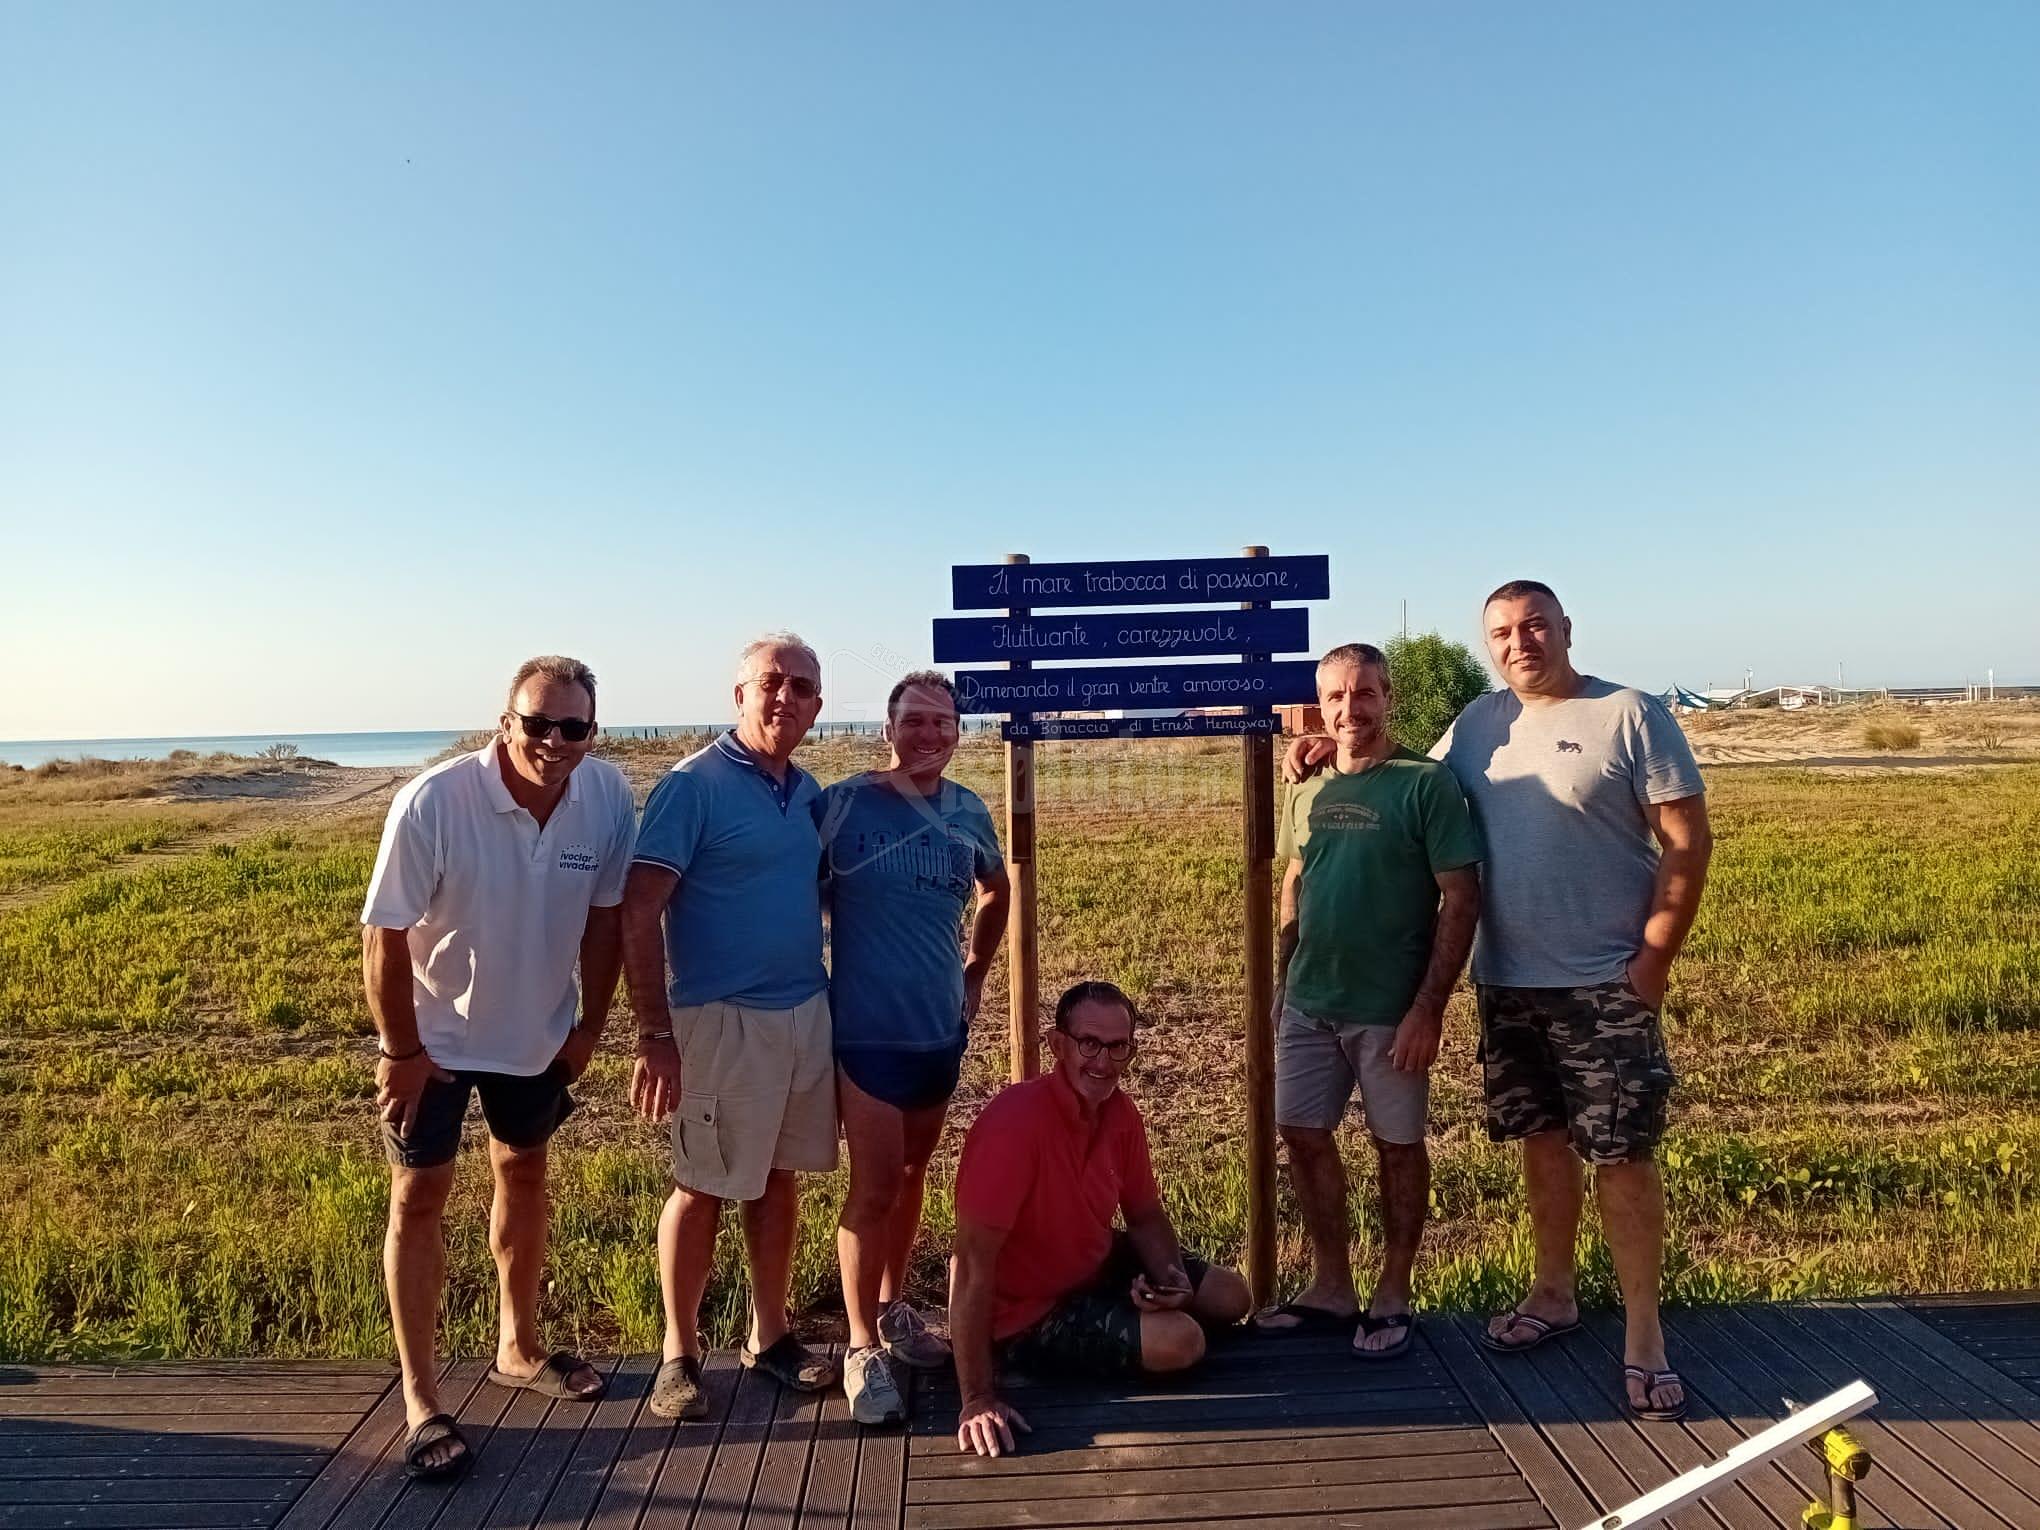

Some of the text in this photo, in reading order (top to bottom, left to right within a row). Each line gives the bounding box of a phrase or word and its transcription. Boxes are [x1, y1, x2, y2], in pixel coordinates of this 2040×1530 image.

[1023, 577, 1073, 594] mare
[1084, 570, 1167, 593] trabocca
[1179, 566, 1199, 590] di
[960, 676, 1059, 700] Dimenando
[1067, 677, 1076, 697] il
[1081, 682, 1119, 707] gran
[1129, 676, 1171, 695] ventre
[1009, 722, 1029, 735] da
[1128, 719, 1142, 732] di
[1152, 717, 1196, 732] Ernest
[1204, 716, 1276, 736] Hemigway
[559, 861, 599, 872] vivadent
[560, 851, 594, 863] ivoclar
